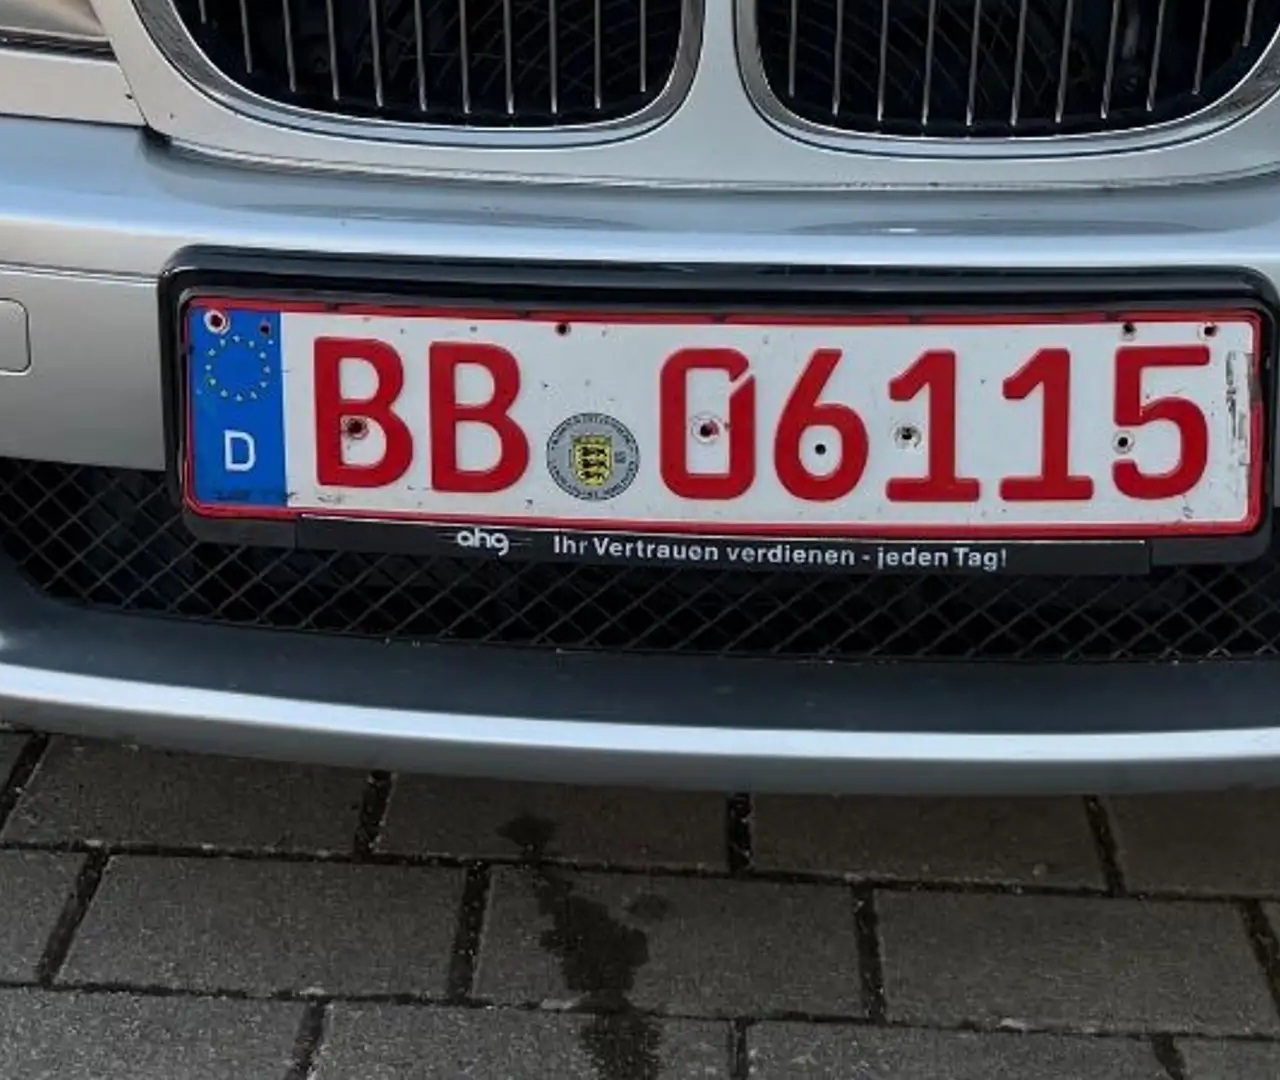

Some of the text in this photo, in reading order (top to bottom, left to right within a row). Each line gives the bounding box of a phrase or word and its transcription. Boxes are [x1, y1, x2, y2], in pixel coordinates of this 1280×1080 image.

[314, 336, 530, 493] BB
[659, 344, 1210, 502] 06115
[224, 429, 256, 471] D
[456, 528, 510, 556] ahg
[553, 535, 588, 555] Ihr
[592, 536, 719, 561] Vertrauen
[726, 545, 856, 566] verdienen
[877, 547, 949, 570] jeden
[952, 547, 1008, 571] Tag!
